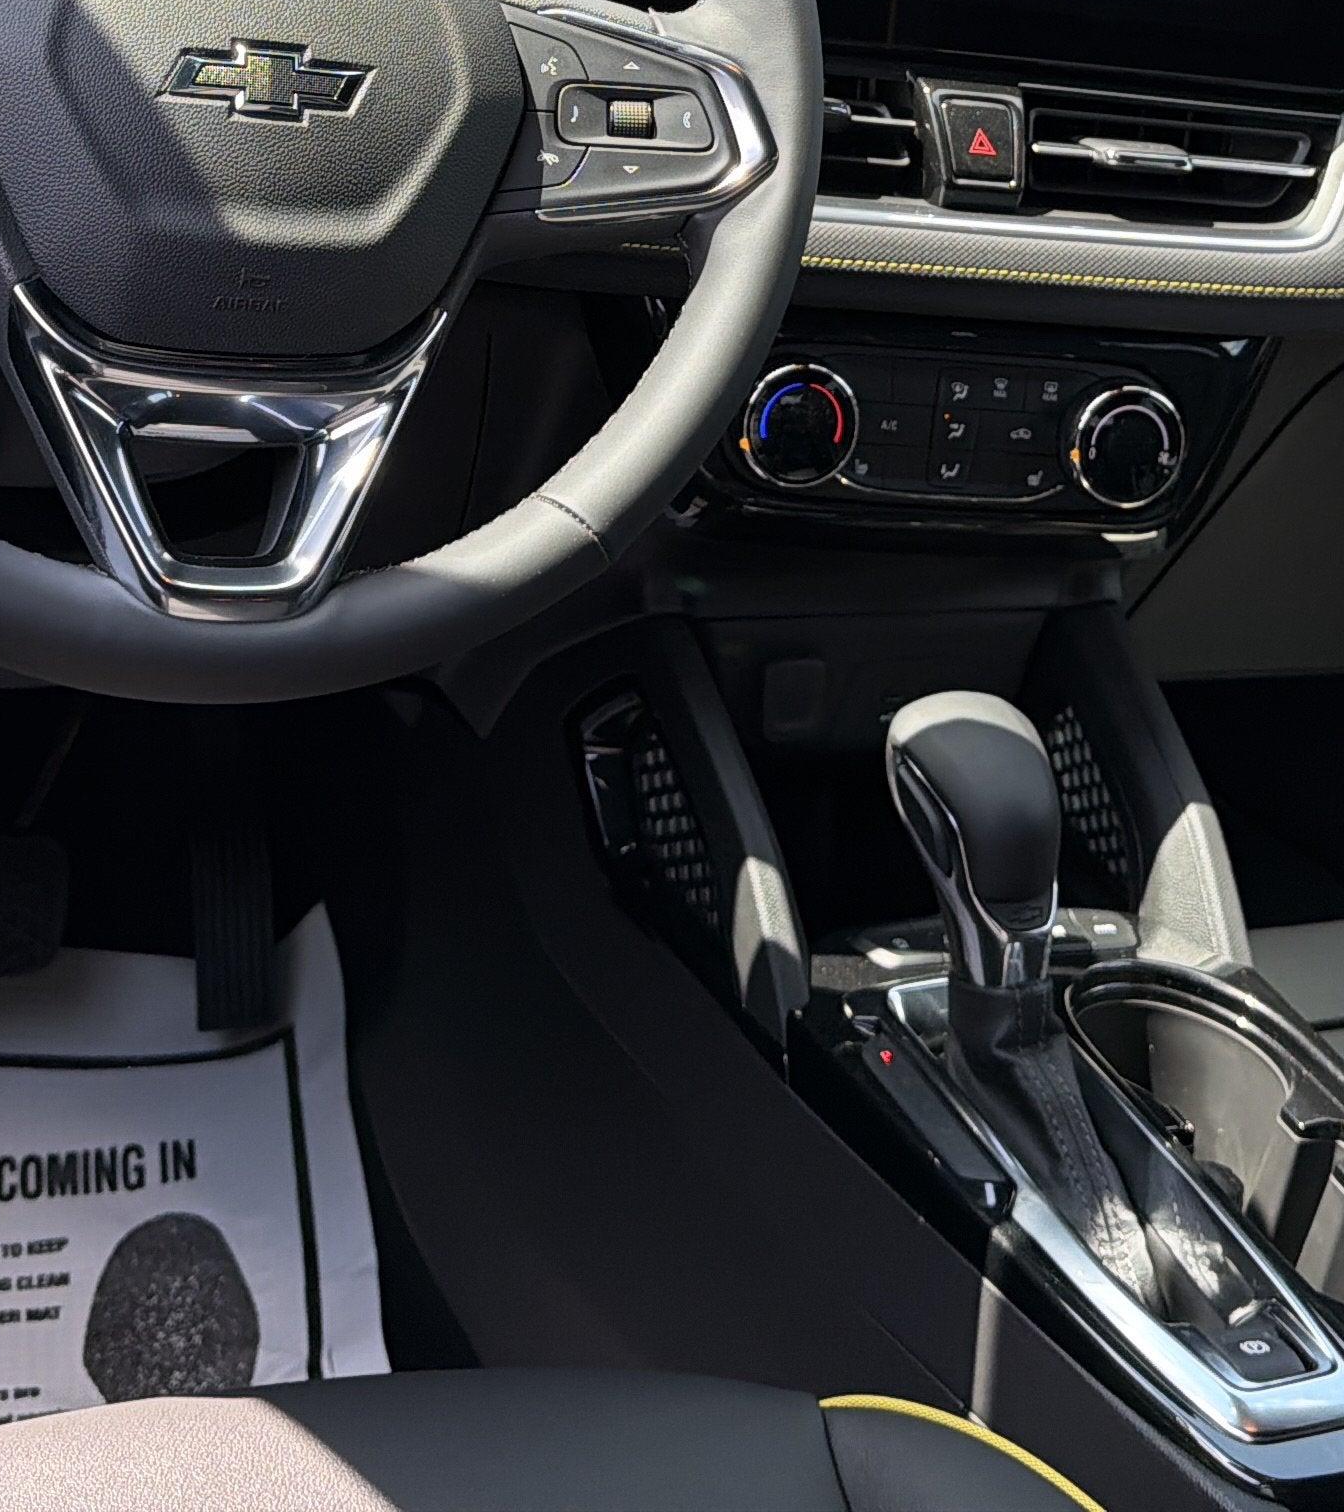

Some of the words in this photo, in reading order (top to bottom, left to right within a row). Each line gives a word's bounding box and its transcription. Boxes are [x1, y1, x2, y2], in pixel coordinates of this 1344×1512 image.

[881, 419, 898, 432] A/C
[159, 1138, 197, 1185] IN
[1, 1242, 23, 1259] TO
[27, 1236, 69, 1257] KEEP
[16, 1271, 72, 1291] CLEAN
[25, 1304, 62, 1322] MAT
[13, 1386, 41, 1400] are
